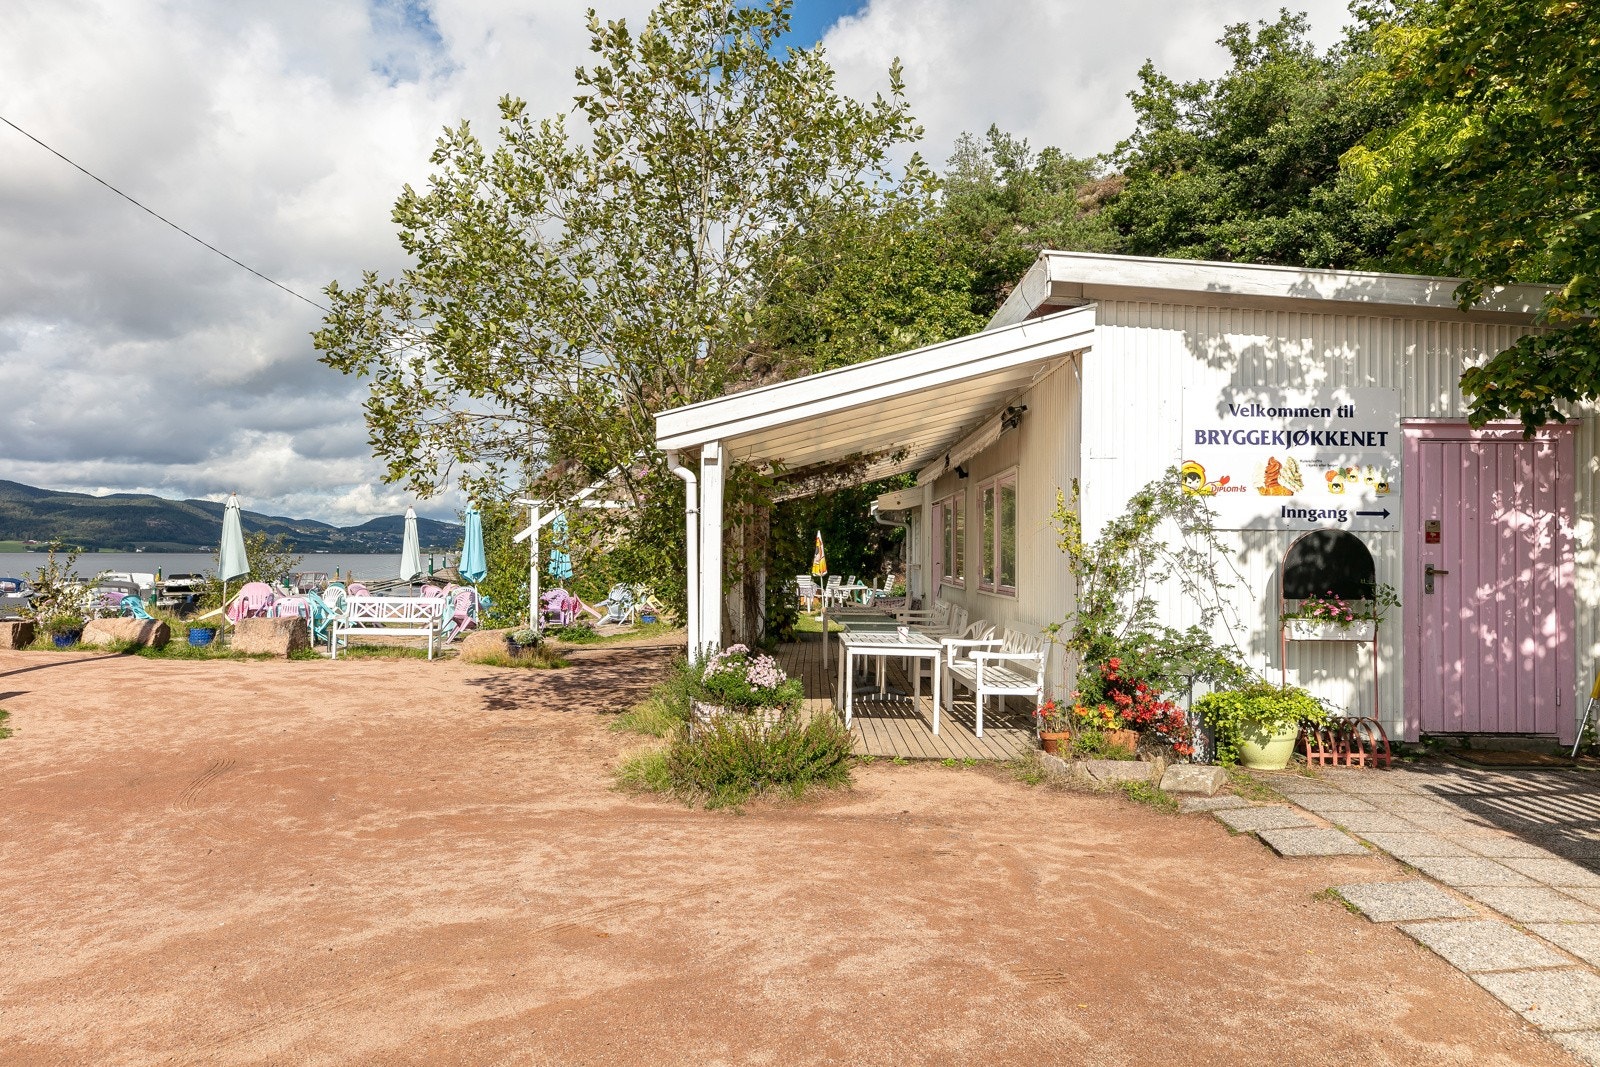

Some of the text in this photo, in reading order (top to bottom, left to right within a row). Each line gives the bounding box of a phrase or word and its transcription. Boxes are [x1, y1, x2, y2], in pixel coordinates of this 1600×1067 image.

[1229, 404, 1354, 418] Velkommen til
[1194, 429, 1389, 450] BRYGGEKJØKKENET
[1281, 505, 1348, 522] Inngang
